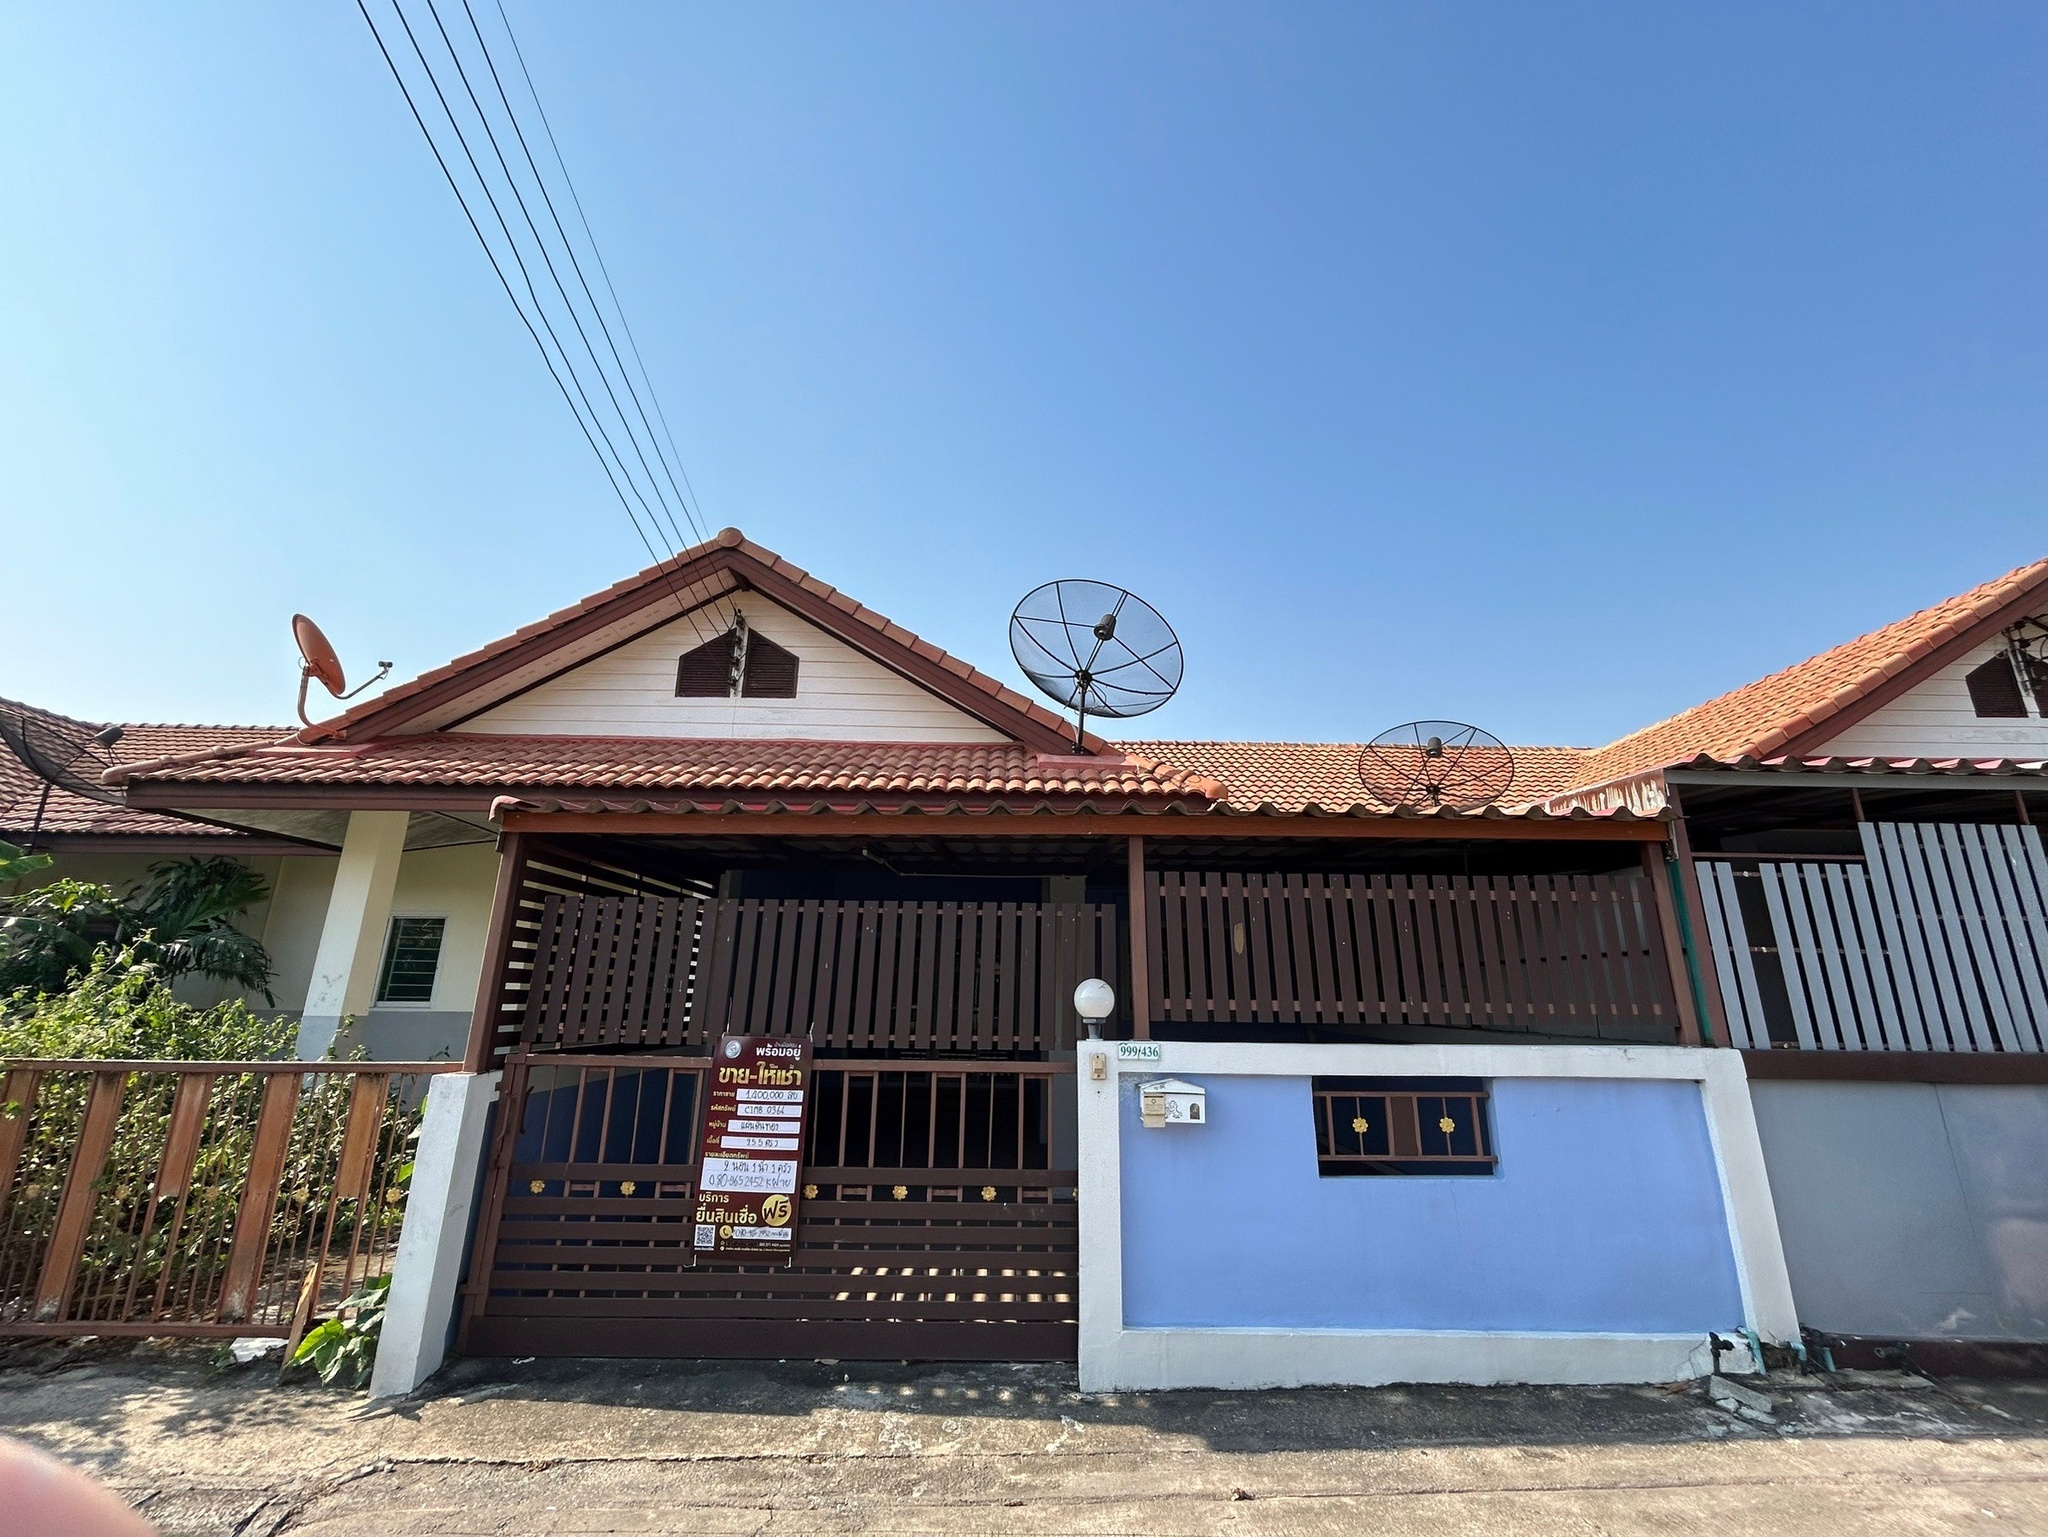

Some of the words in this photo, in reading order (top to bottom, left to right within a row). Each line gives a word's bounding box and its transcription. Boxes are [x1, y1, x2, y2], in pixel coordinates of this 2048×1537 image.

[756, 1042, 801, 1060] พร้อมอยู่
[1120, 1045, 1159, 1058] 999/436
[719, 1061, 802, 1086] ขาย-ให้เช่า
[744, 1106, 763, 1114] CIMB
[698, 1191, 730, 1203] บริการ
[695, 1202, 758, 1224] ยื่นสินเชื่อ
[763, 1199, 789, 1221] ฟรี
